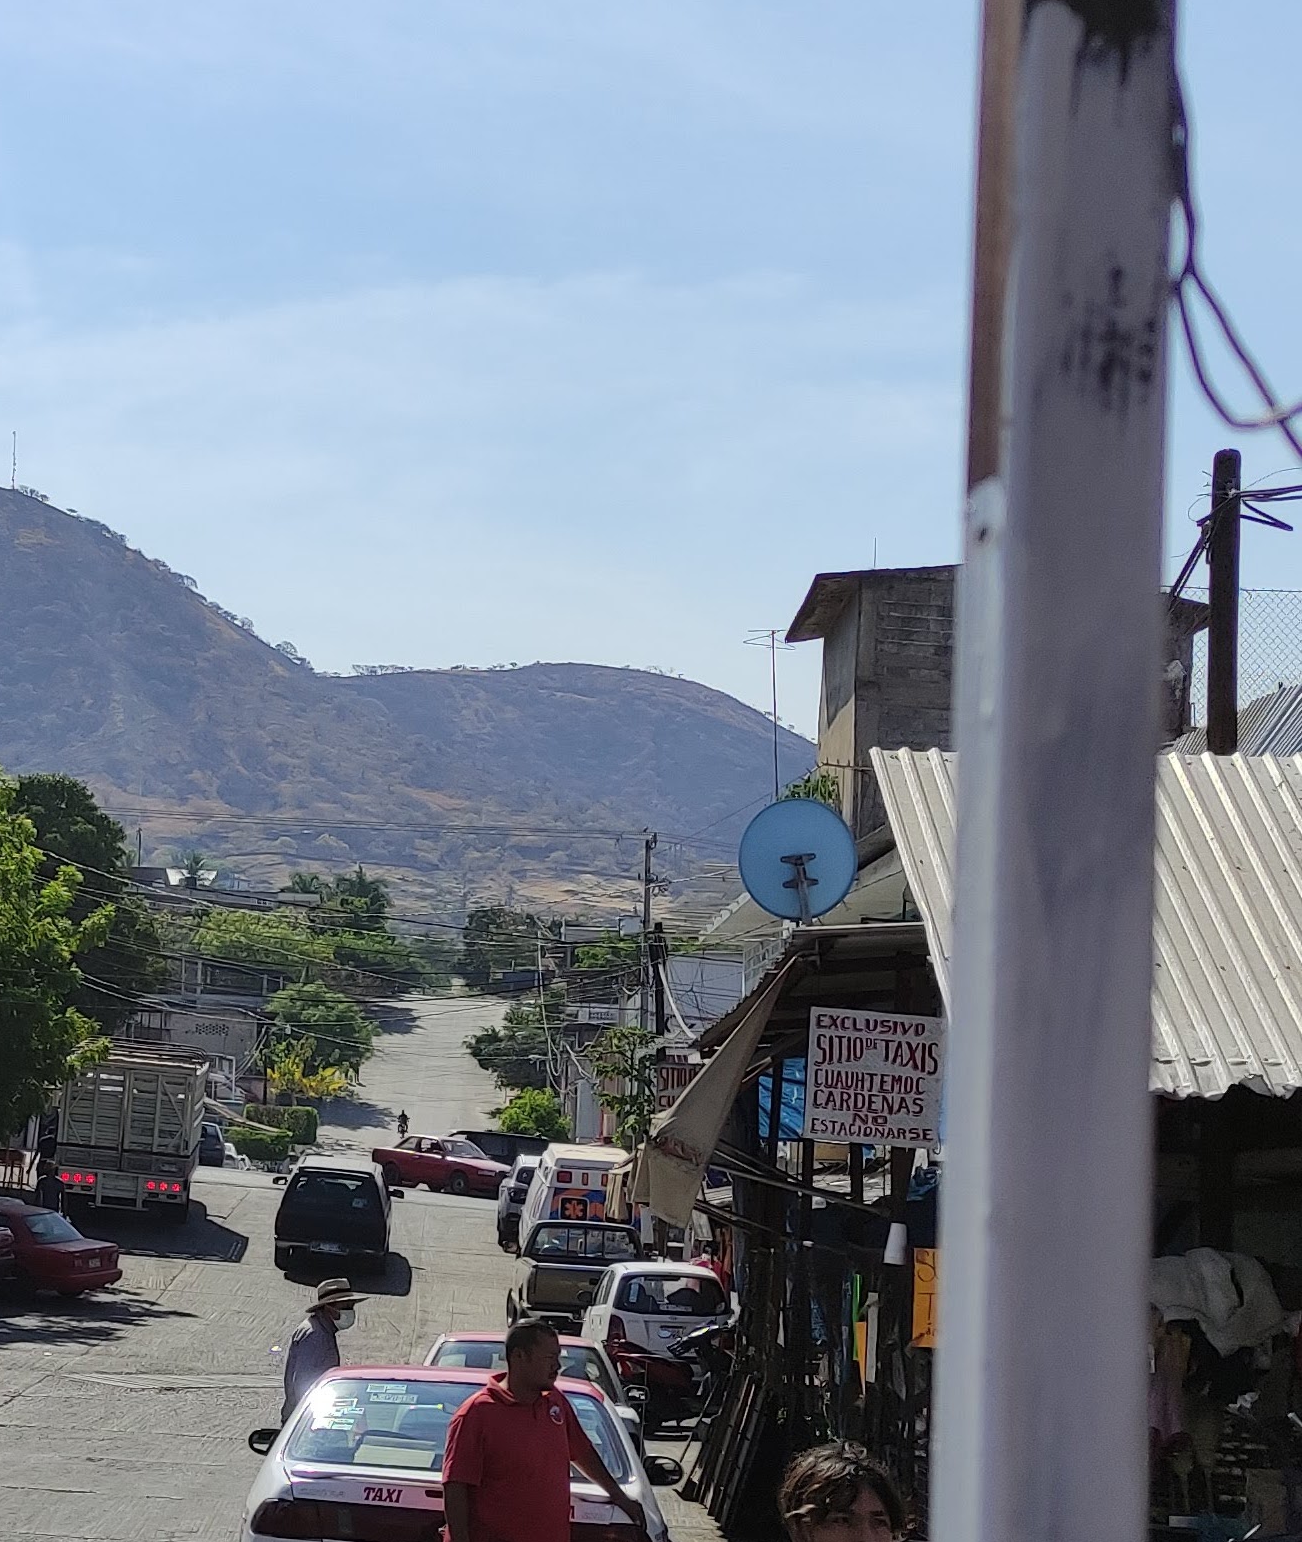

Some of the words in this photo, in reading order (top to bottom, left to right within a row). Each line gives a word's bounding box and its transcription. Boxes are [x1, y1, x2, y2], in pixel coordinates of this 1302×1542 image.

[816, 1013, 926, 1037] EXCLUSIVO
[814, 1033, 864, 1067] SITIO
[879, 1039, 939, 1075] TAXIS
[814, 1068, 926, 1096] CUAUHTEMOC
[812, 1089, 924, 1117] CARDENAS
[810, 1117, 934, 1141] ESTACIONARSE
[852, 1113, 888, 1127] NO
[363, 1486, 403, 1504] TAXI
